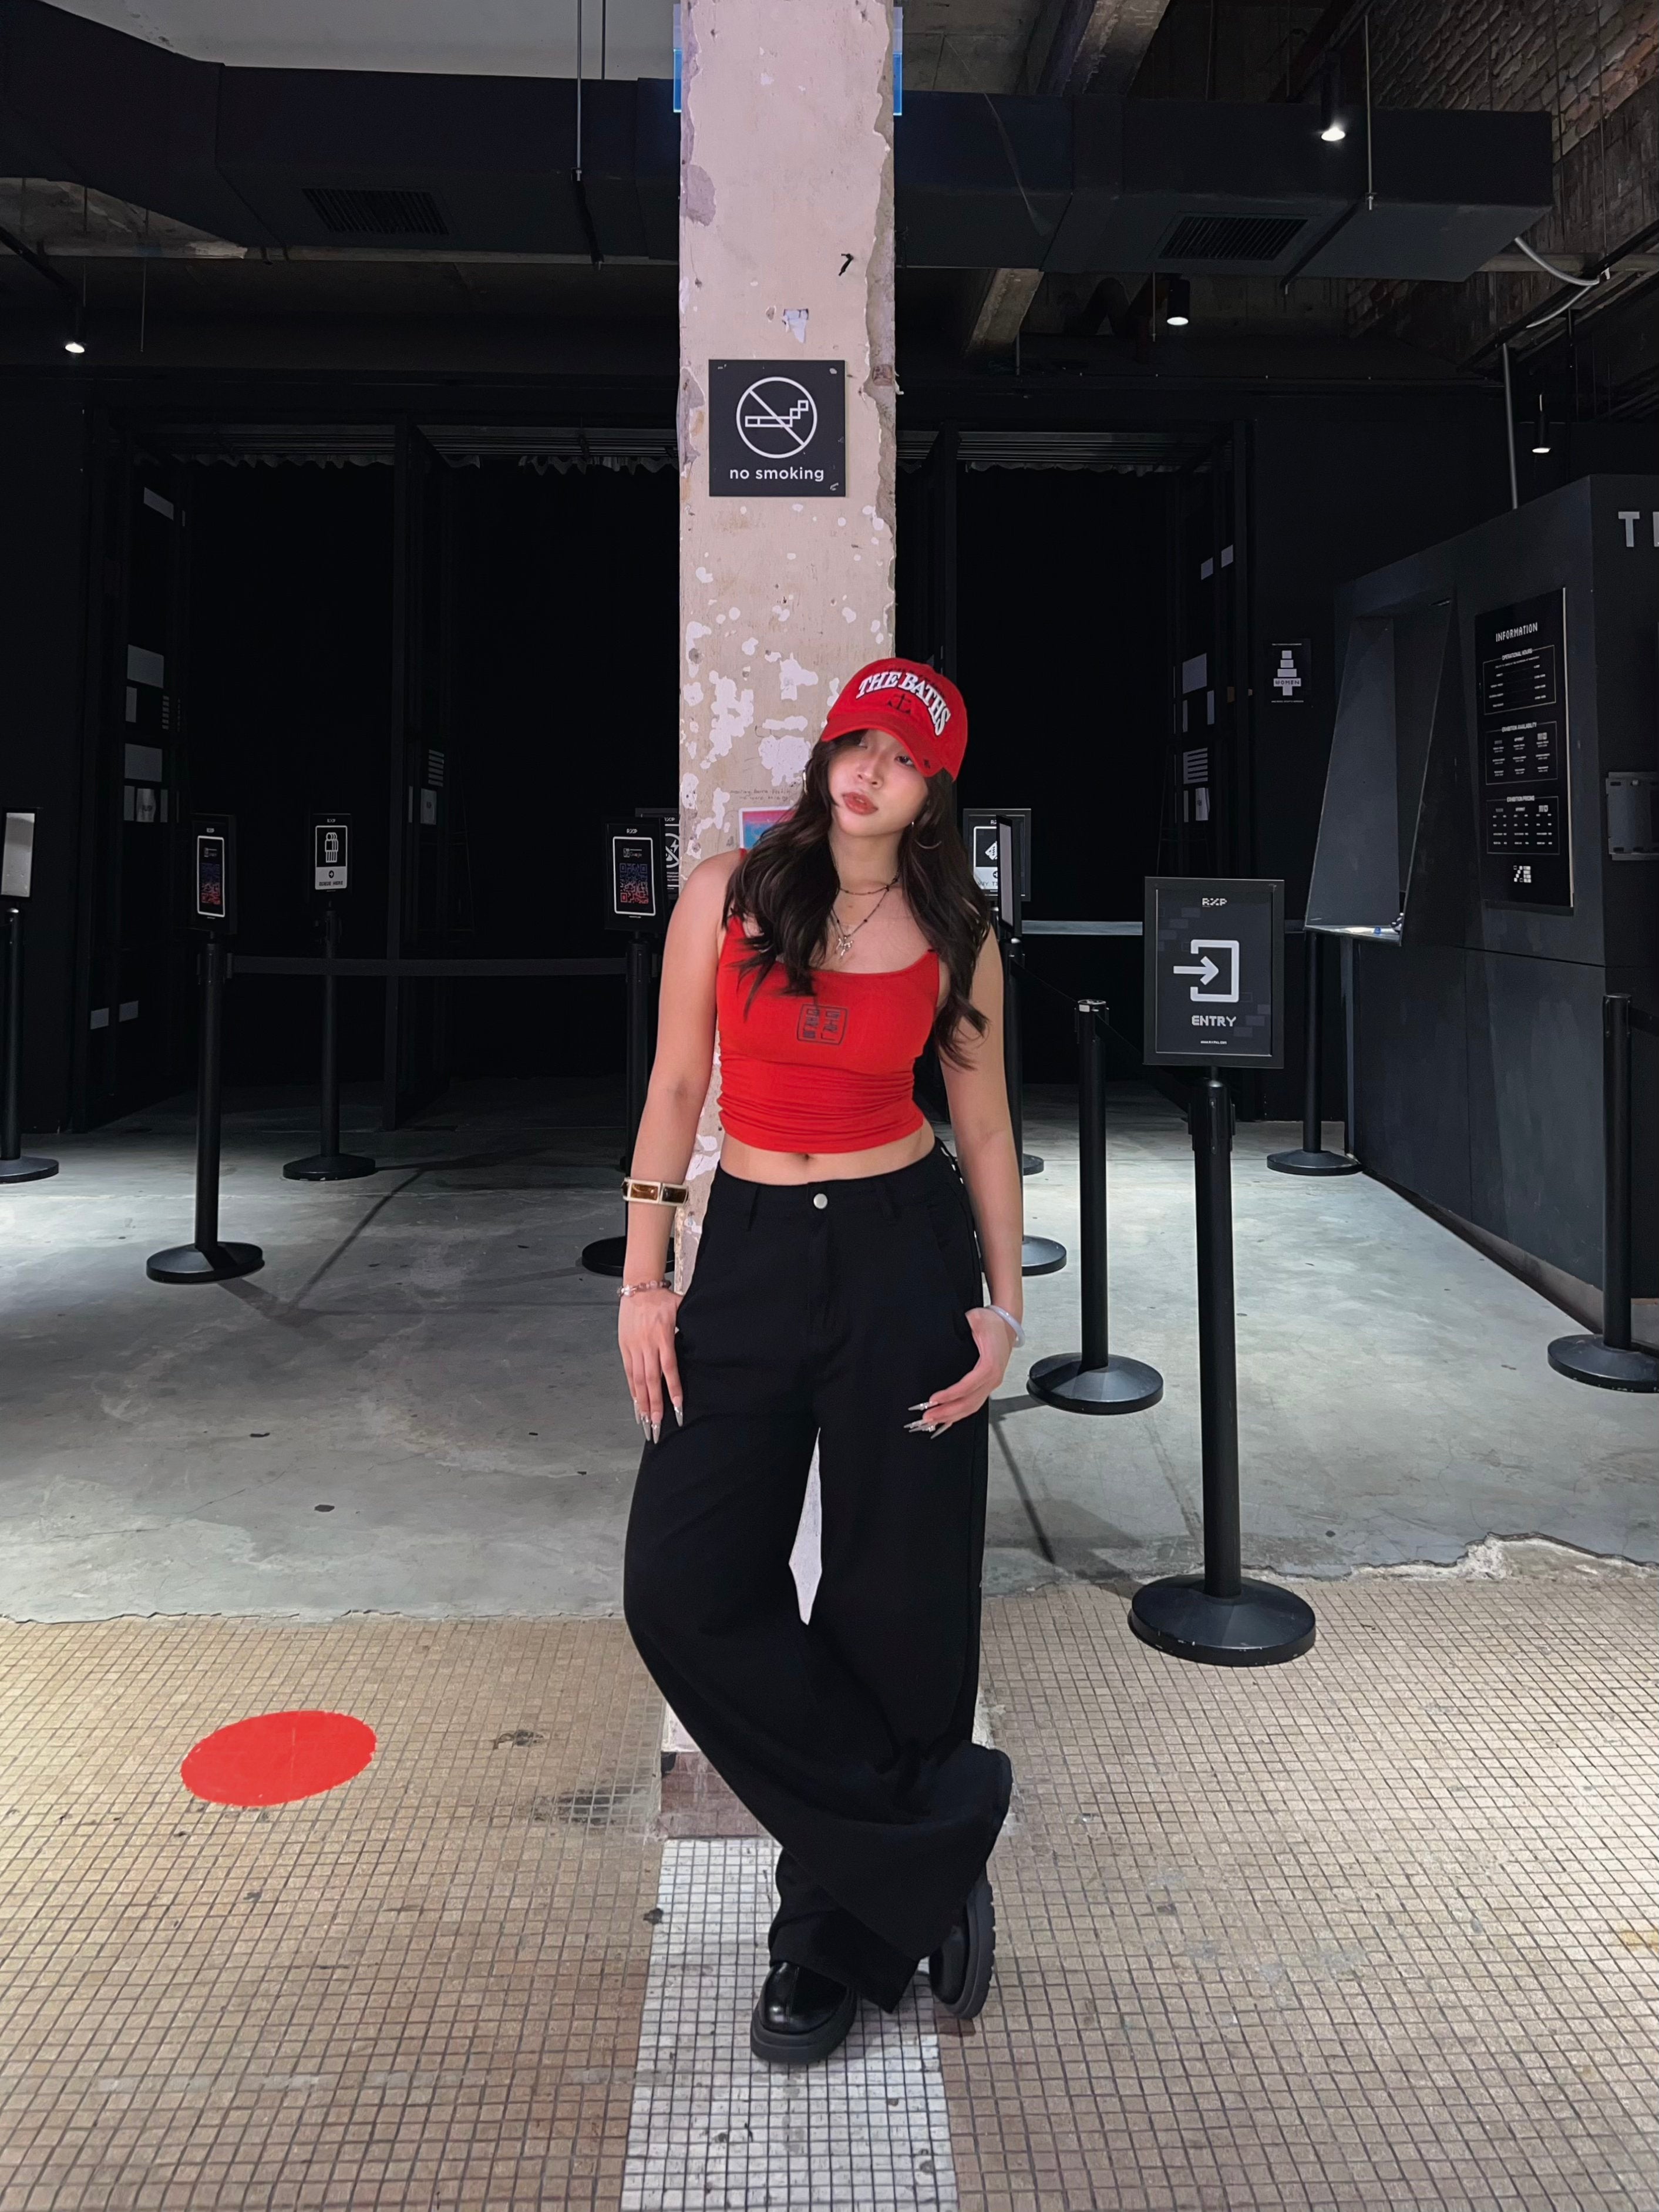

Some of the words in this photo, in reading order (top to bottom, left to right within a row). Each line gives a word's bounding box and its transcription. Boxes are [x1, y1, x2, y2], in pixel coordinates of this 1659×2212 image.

[729, 469, 749, 479] no
[755, 467, 824, 482] smoking
[1496, 622, 1538, 642] INFORMATION
[856, 671, 902, 699] THE
[898, 672, 951, 735] BATHS
[1202, 897, 1227, 906] RXP
[1191, 1015, 1237, 1027] ENTRY
